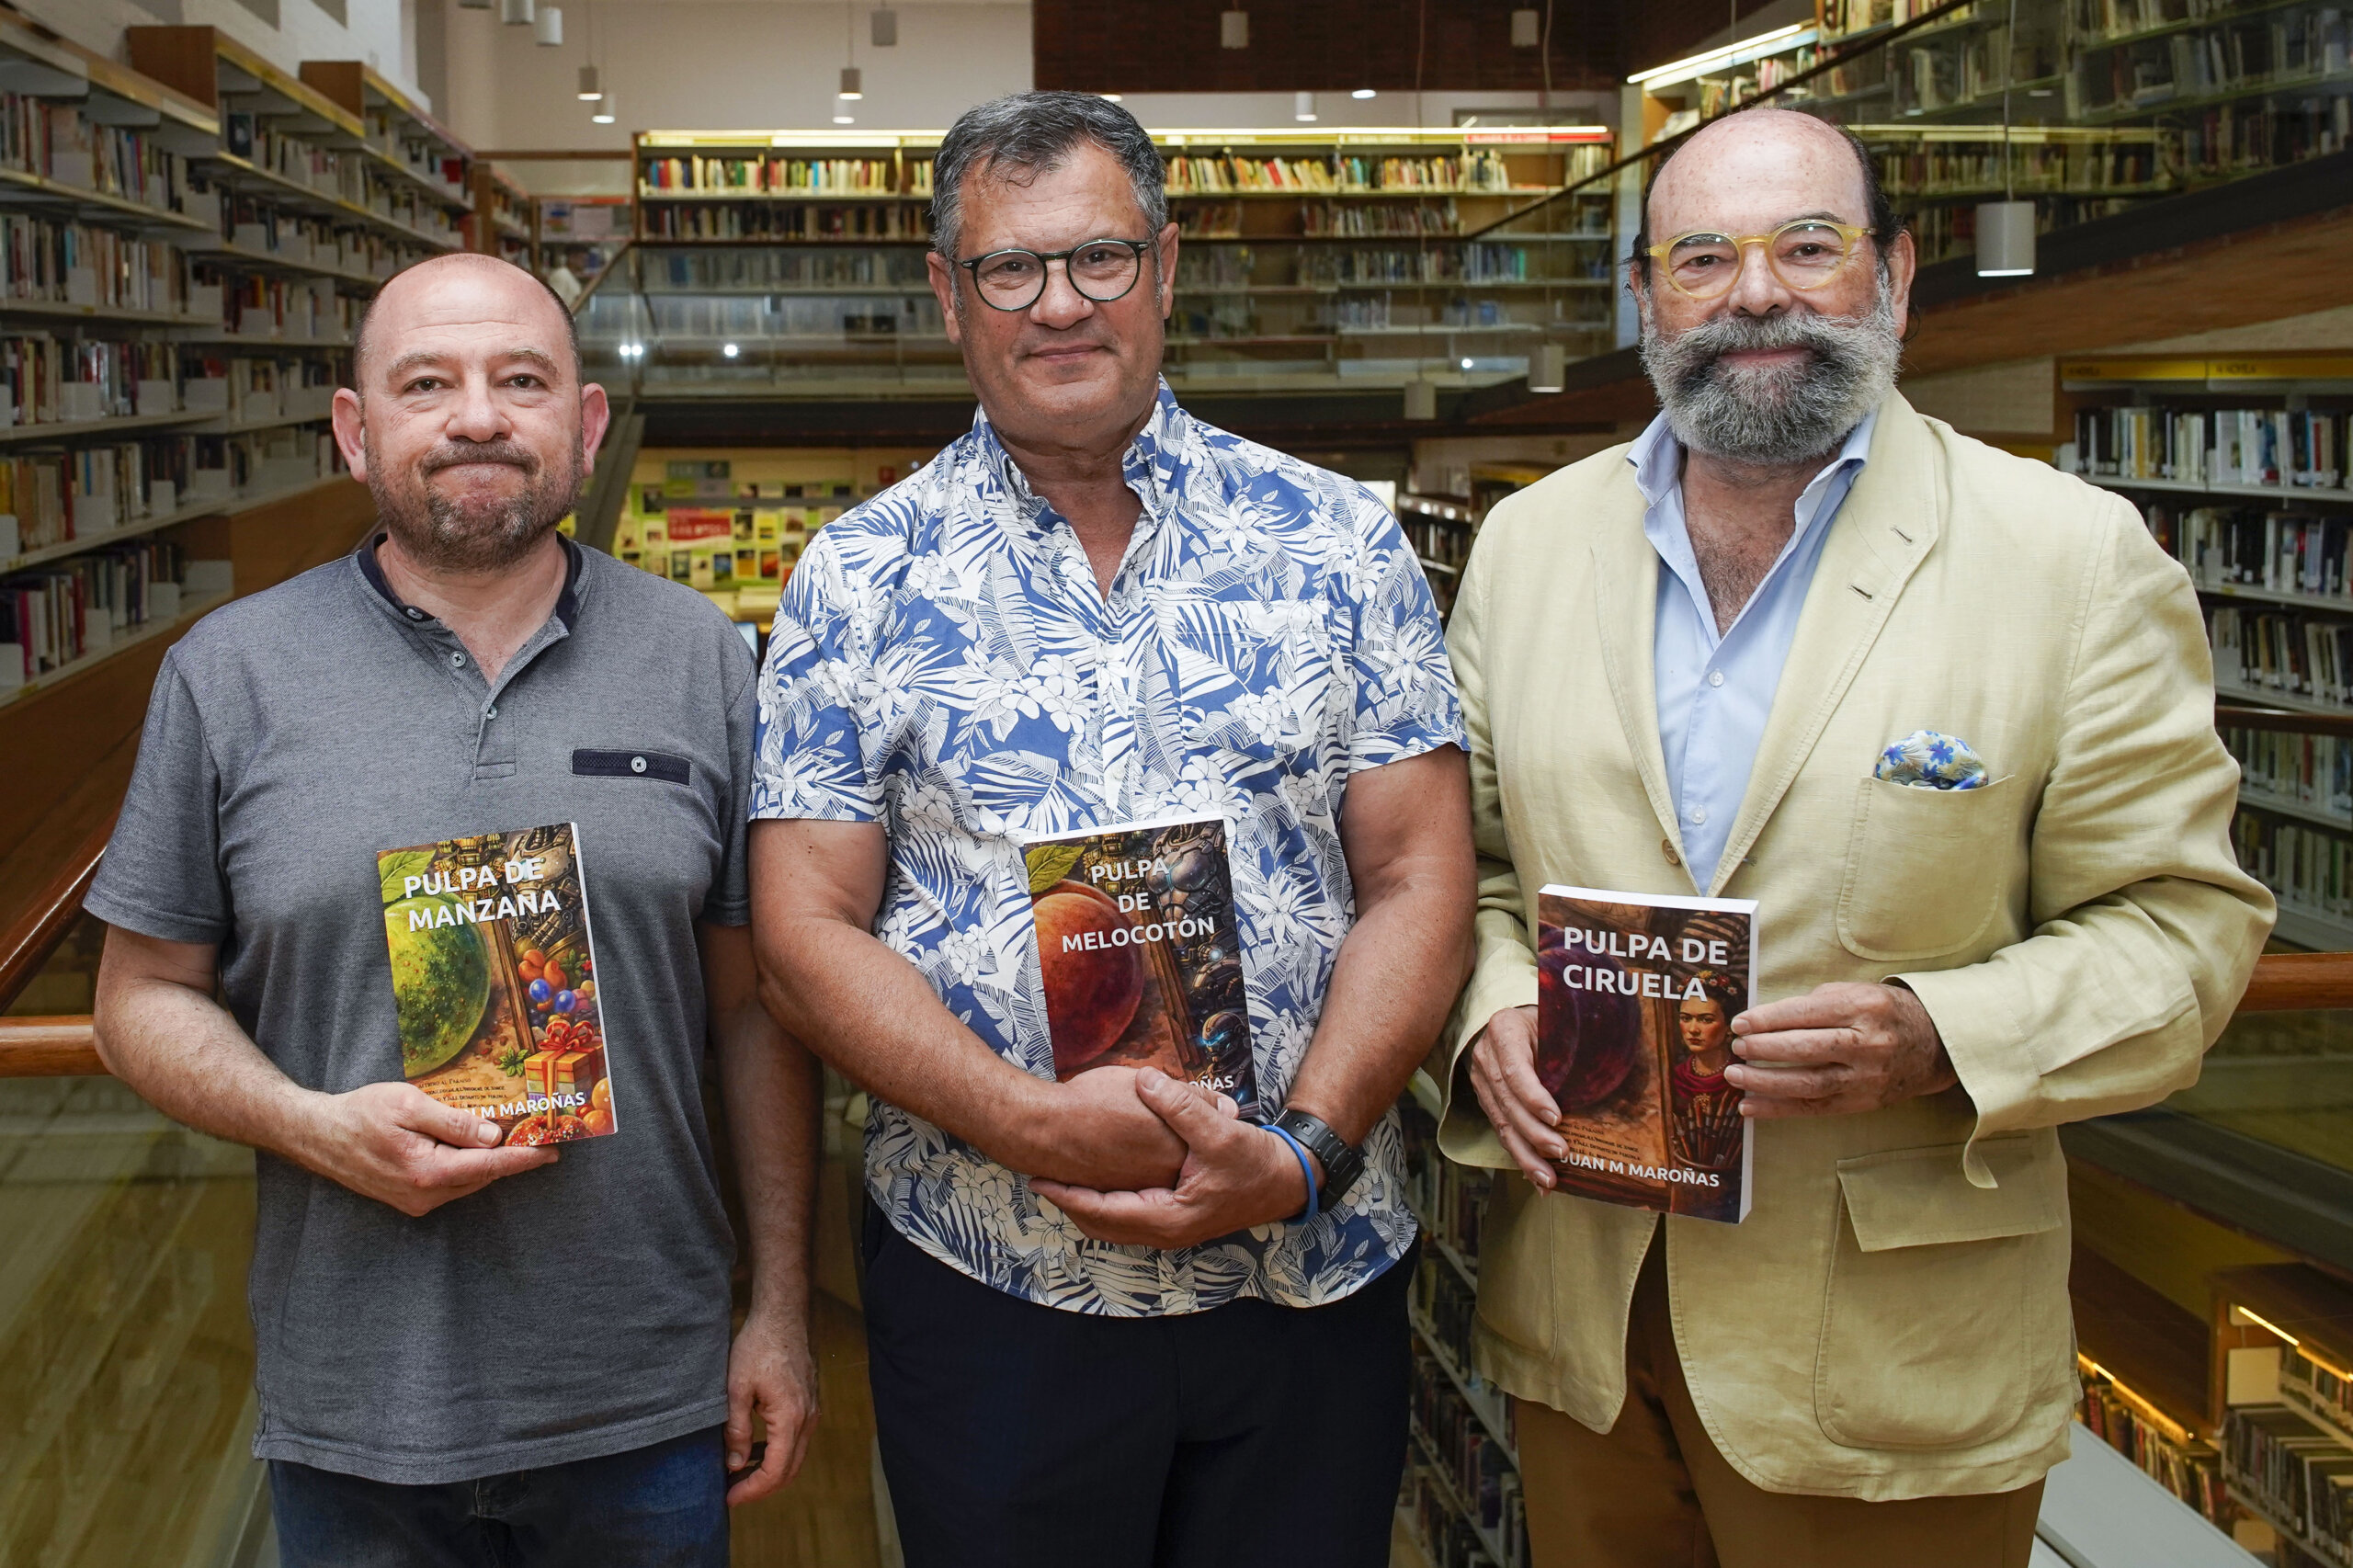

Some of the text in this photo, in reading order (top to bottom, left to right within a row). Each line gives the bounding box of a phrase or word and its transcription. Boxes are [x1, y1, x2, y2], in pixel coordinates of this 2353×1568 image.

[404, 857, 545, 899] PULPA DE
[1090, 857, 1170, 884] PULPA
[408, 890, 562, 933] MANZANA
[1118, 892, 1151, 914] DE
[1062, 915, 1216, 953] MELOCOTÓN
[1563, 926, 1728, 965] PULPA DE
[1563, 963, 1708, 1002] CIRUELA
[481, 1091, 586, 1119] M MAROÑAS
[1608, 1160, 1624, 1175] M
[1628, 1160, 1720, 1188] MAROÑAS
